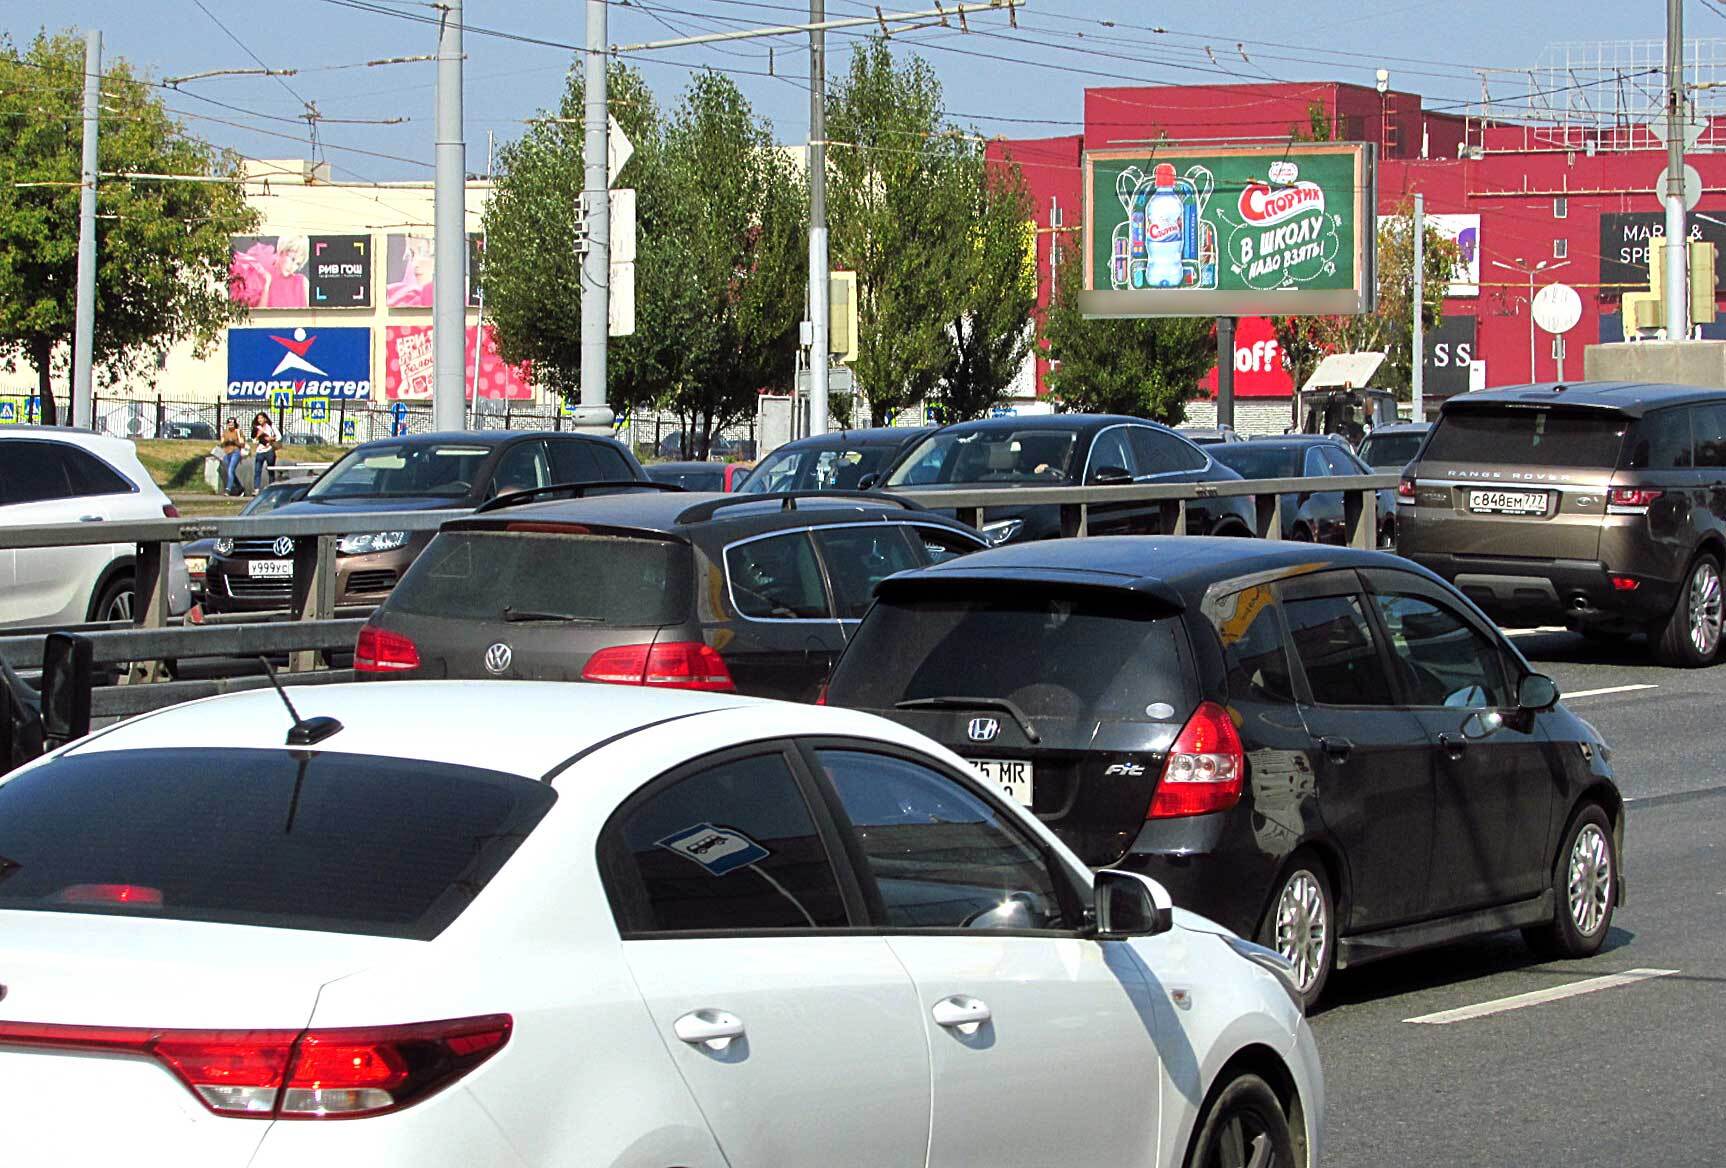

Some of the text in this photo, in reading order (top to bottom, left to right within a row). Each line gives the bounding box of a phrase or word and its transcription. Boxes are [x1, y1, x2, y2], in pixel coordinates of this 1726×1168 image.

[1259, 216, 1324, 256] ШКОЛУ
[1623, 225, 1665, 242] MAR
[1248, 240, 1325, 281] НАДО ВЗЯТЬ!
[1620, 247, 1650, 264] SPE
[318, 264, 363, 275] РИВ ГОШ
[1234, 340, 1279, 373] off
[1433, 343, 1472, 367] SS
[1447, 470, 1571, 482] RANGE ROVER
[1524, 493, 1545, 505] 777
[1000, 761, 1025, 783] MR
